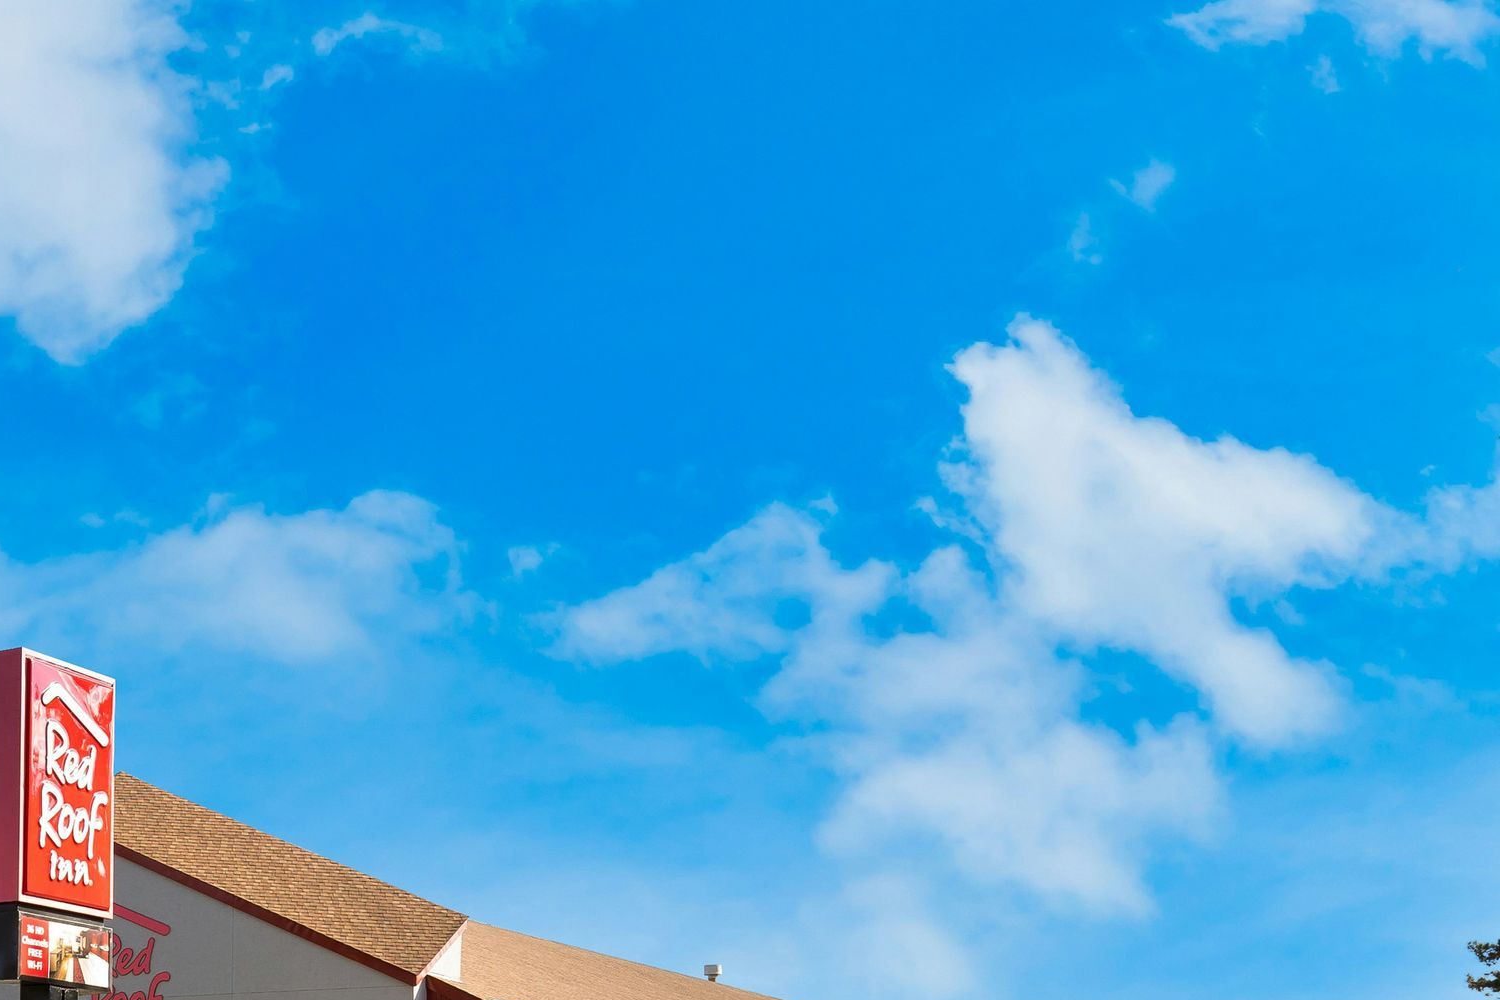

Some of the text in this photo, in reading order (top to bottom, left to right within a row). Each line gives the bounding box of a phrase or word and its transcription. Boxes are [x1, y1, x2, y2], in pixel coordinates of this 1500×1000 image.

[46, 719, 97, 791] Red
[38, 780, 108, 860] Roof
[50, 850, 92, 886] Inn
